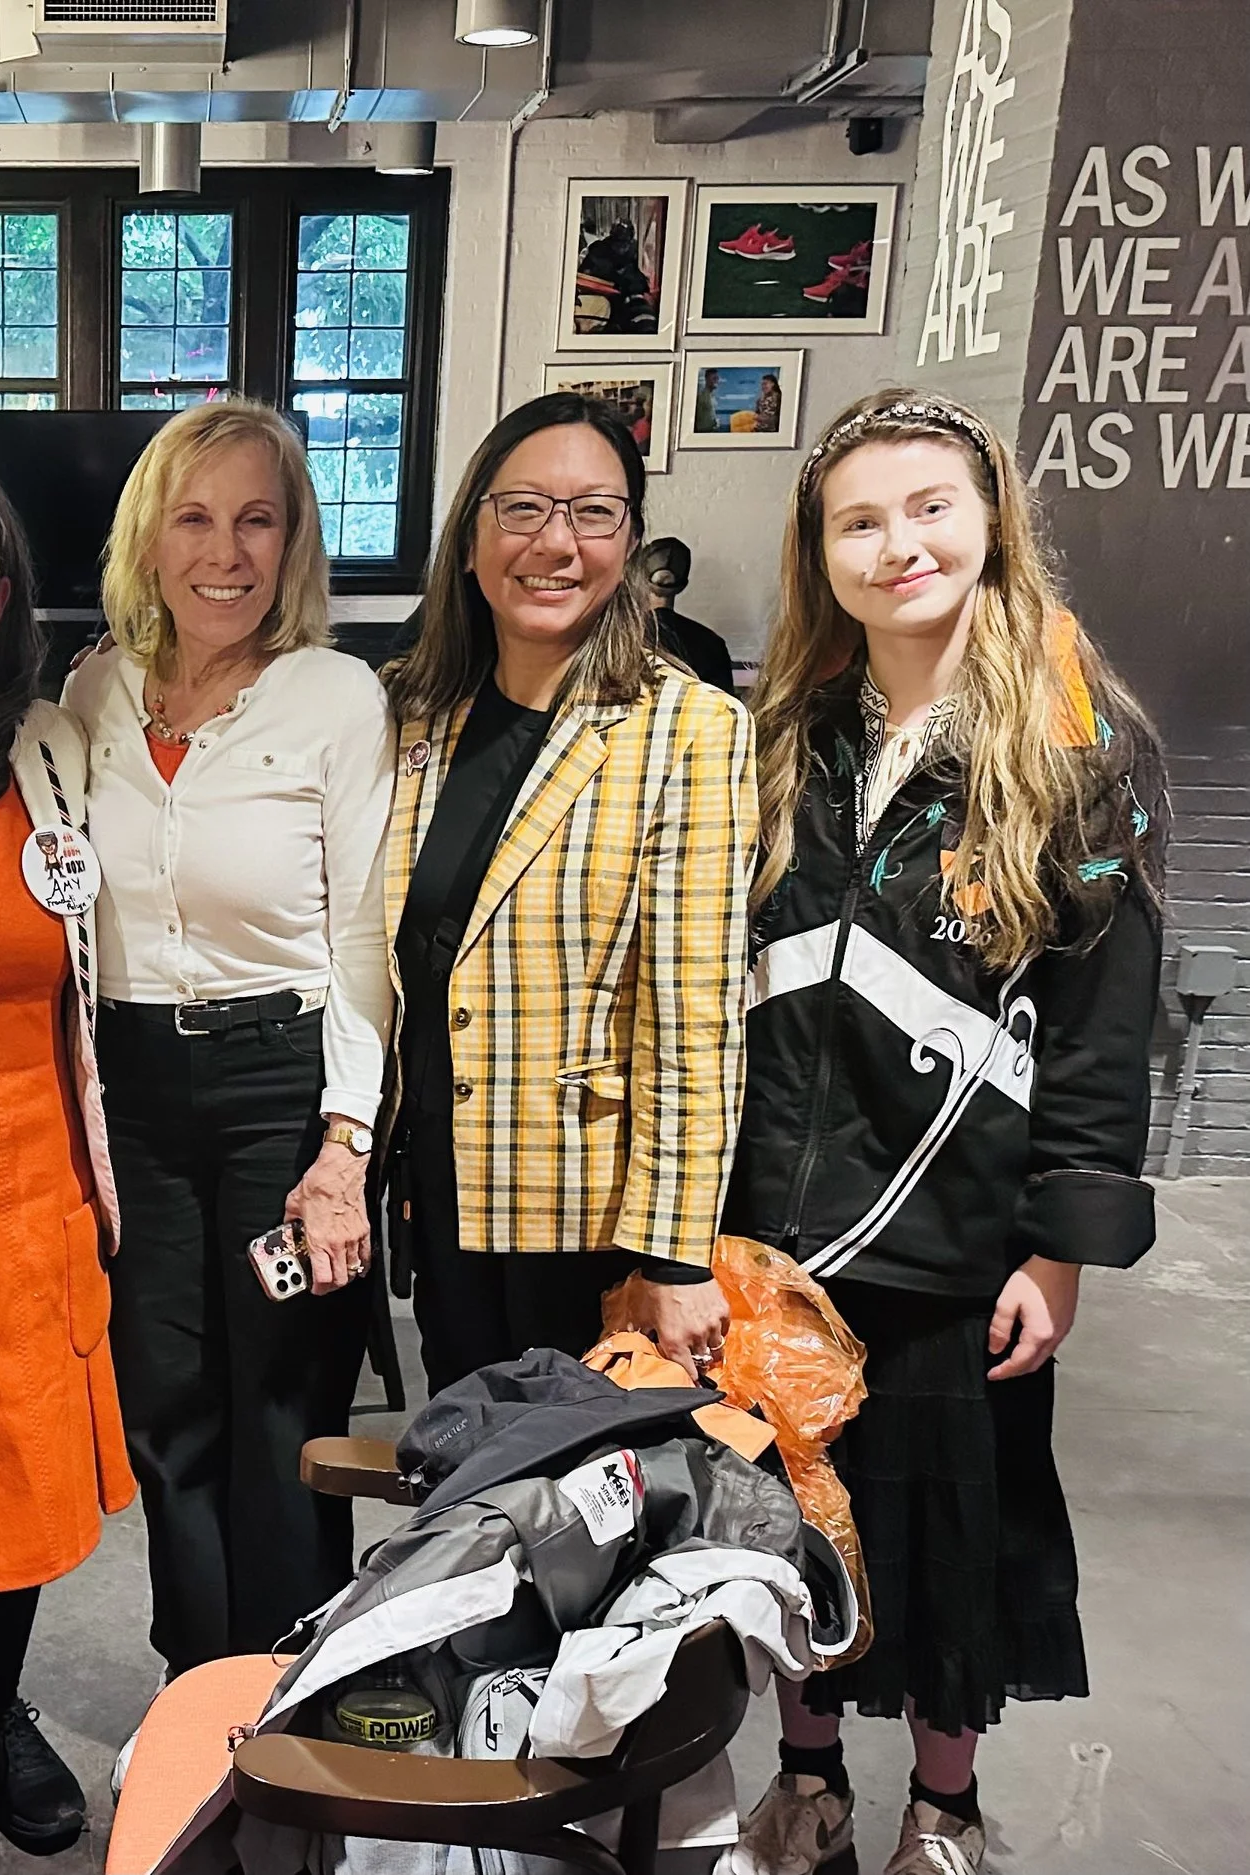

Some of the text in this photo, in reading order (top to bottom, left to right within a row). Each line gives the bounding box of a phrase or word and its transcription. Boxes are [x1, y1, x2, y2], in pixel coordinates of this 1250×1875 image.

[950, 0, 1012, 104] AS
[939, 77, 1015, 239] WE
[1059, 145, 1171, 228] AS
[916, 211, 1015, 367] ARE
[1057, 237, 1250, 316] WE A
[1037, 325, 1198, 403] ARE
[1027, 412, 1134, 490] AS
[600, 1483, 617, 1507] Small
[611, 1476, 631, 1506] REI
